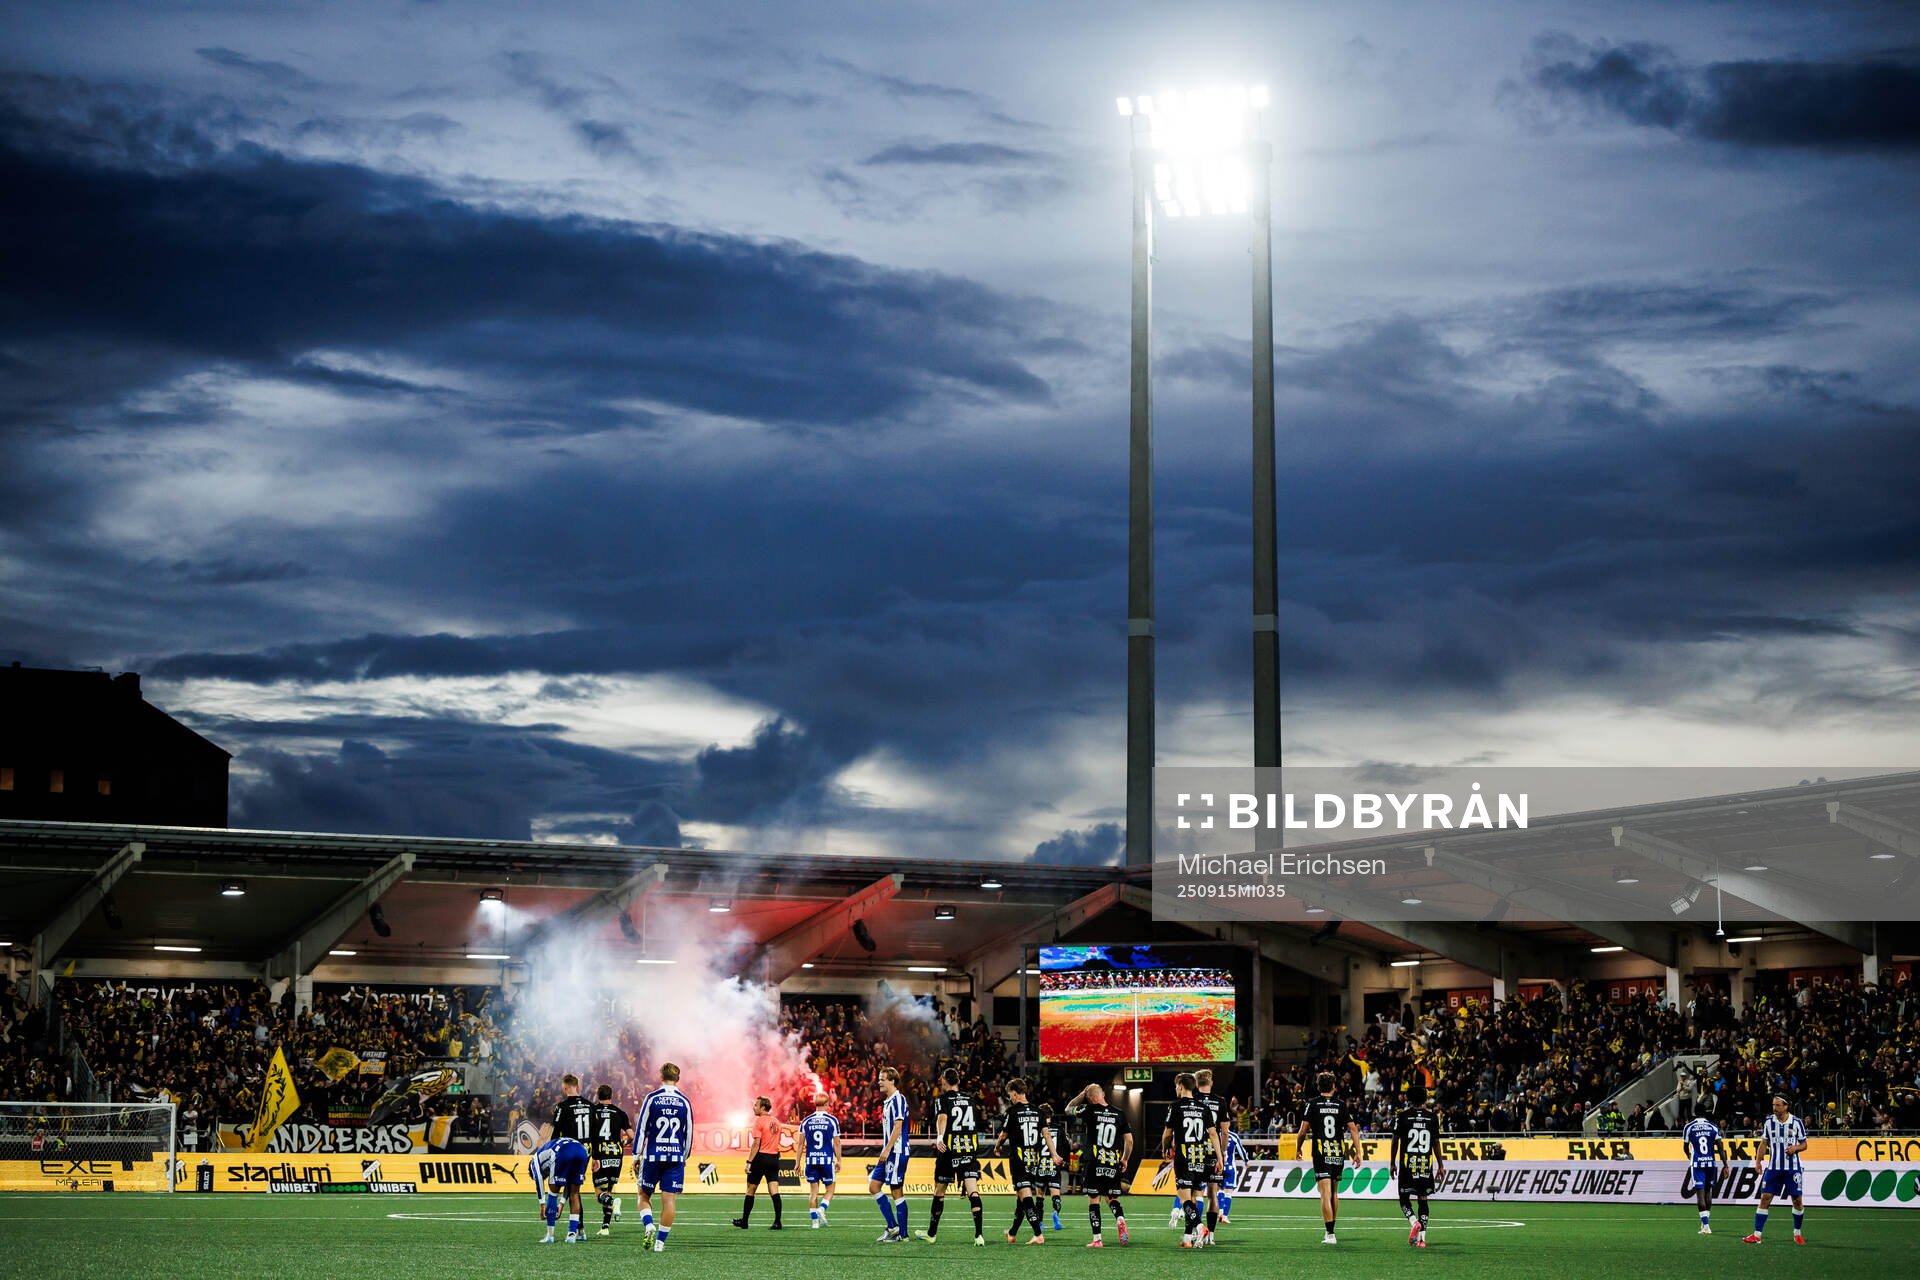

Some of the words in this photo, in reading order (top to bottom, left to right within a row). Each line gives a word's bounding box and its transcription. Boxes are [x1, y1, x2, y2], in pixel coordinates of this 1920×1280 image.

[575, 1114, 590, 1140] 11
[599, 1118, 612, 1141] 4
[655, 1116, 681, 1144] 22
[951, 1106, 976, 1131] 24
[1182, 1117, 1204, 1143] 20
[1323, 1115, 1336, 1139] 8
[813, 1130, 824, 1150] 9
[1020, 1122, 1039, 1147] 15
[1095, 1123, 1117, 1149] 10
[1406, 1128, 1431, 1154] 29
[1698, 1136, 1709, 1155] 8
[655, 1145, 681, 1153] MOBILL
[228, 1162, 332, 1183] stadium
[419, 1162, 493, 1184] PUMA
[1490, 1169, 1531, 1194] LIVE
[1529, 1169, 1571, 1195] HOS
[1571, 1169, 1644, 1196] UNIBET
[272, 1183, 318, 1193] UNIBET
[370, 1183, 416, 1193] UNIBET
